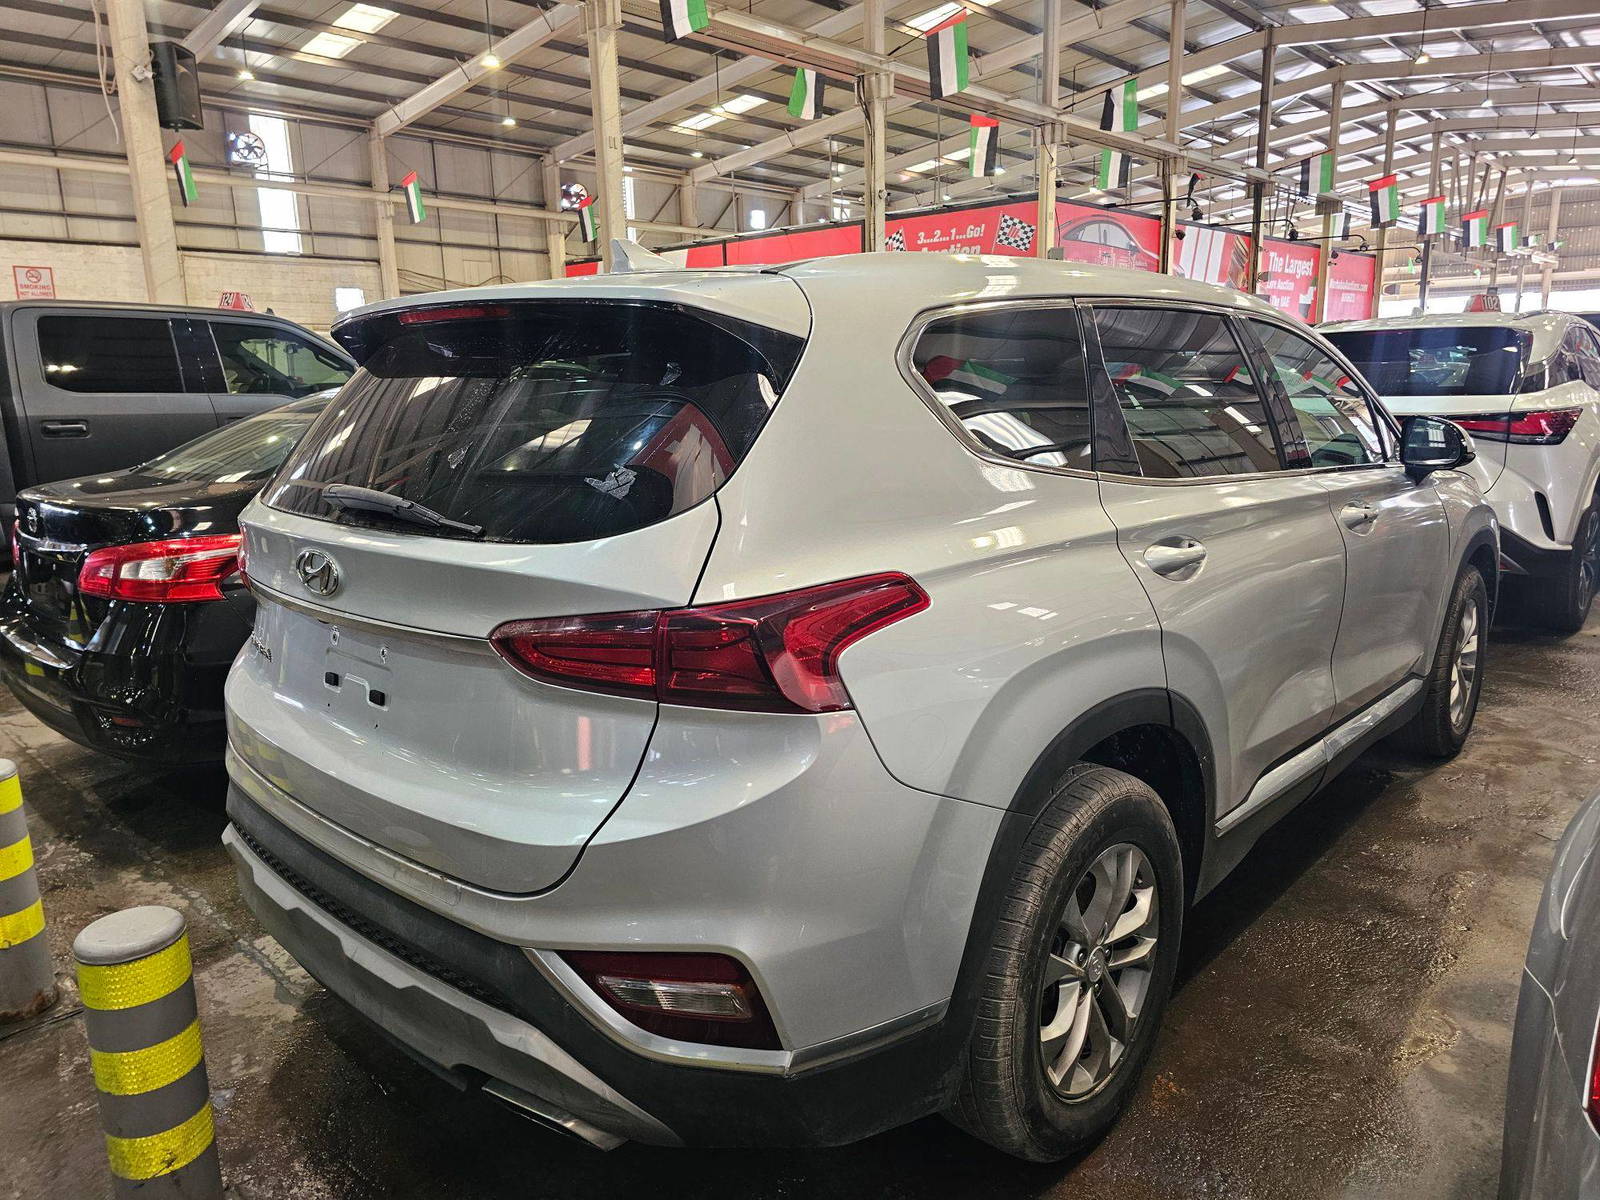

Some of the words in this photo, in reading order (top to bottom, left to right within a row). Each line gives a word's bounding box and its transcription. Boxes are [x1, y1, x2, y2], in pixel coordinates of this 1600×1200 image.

[1269, 252, 1283, 273] The
[1285, 254, 1313, 278] Largest
[1483, 295, 1500, 310] 102
